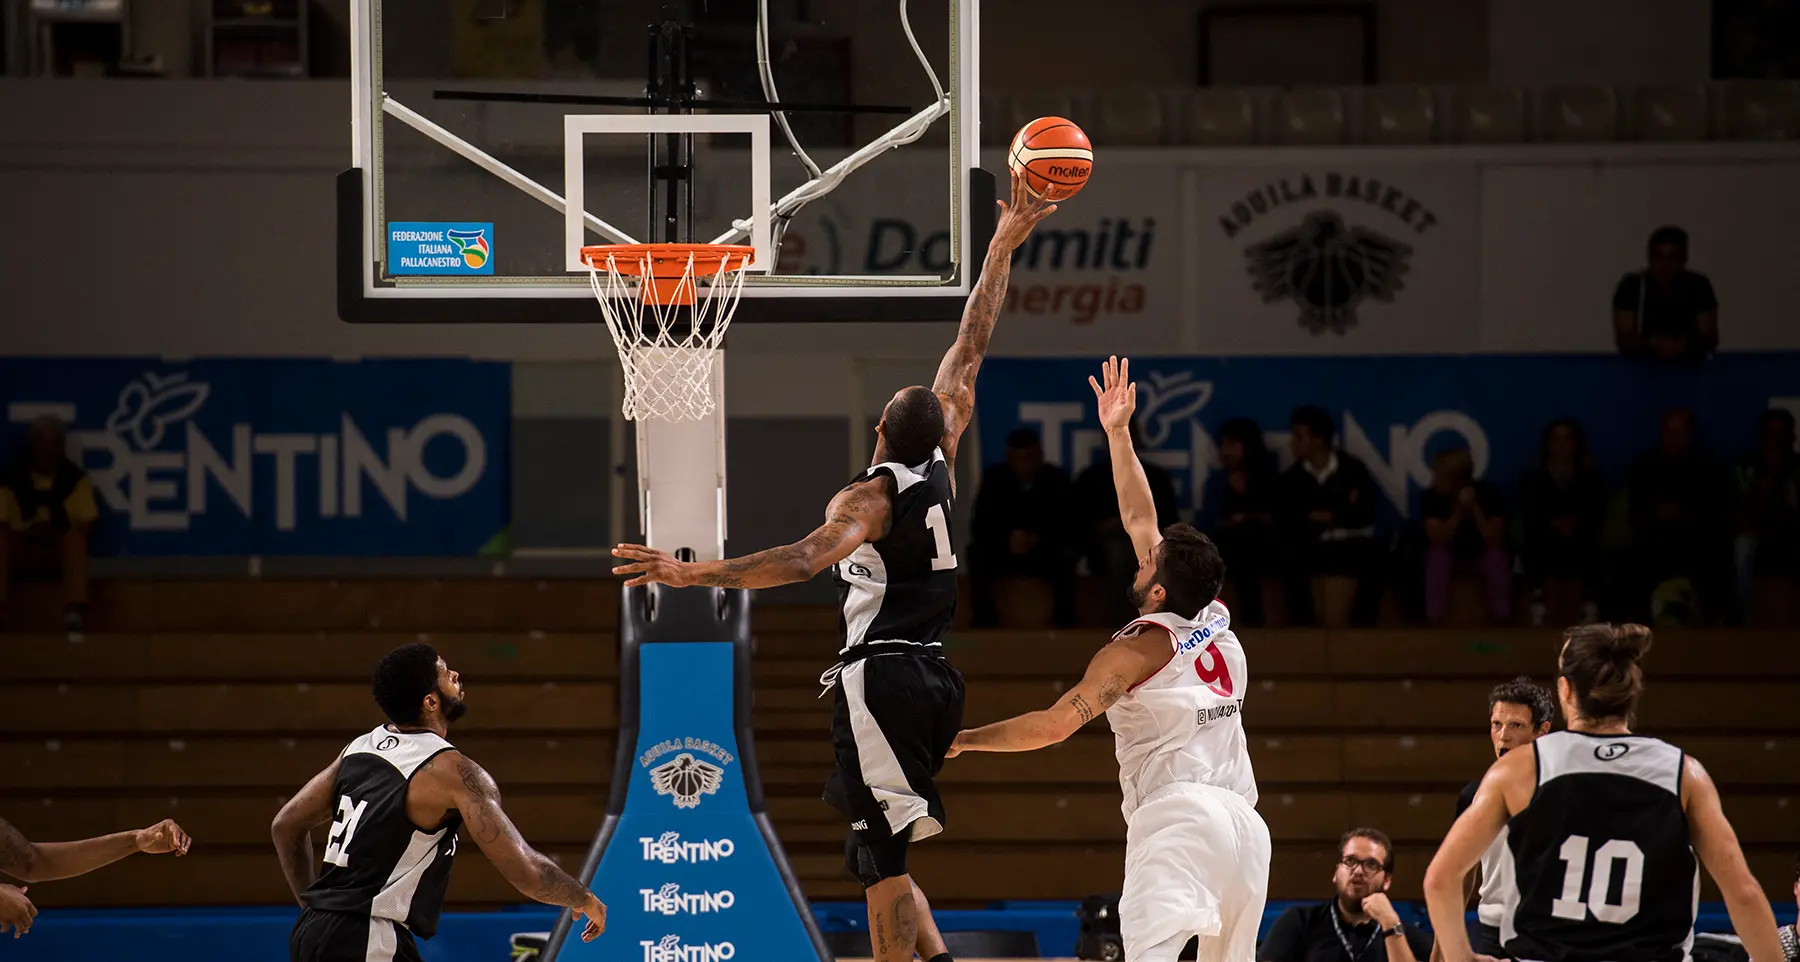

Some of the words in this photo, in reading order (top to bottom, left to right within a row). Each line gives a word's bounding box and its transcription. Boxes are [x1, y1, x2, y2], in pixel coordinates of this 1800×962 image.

[1048, 165, 1090, 178] molten
[1218, 172, 1318, 239] AQUILA
[1324, 171, 1438, 234] BASKET
[391, 230, 444, 242] FEDERAZIONE
[418, 243, 453, 255] ITALIANA
[867, 217, 1157, 271] Domiti
[400, 256, 462, 268] PALLACANESTRO
[1194, 641, 1233, 698] 9
[639, 737, 684, 769] AQUILA
[684, 736, 735, 766] BASKET
[322, 794, 369, 868] 21
[638, 836, 735, 864] TRENTINO
[1550, 833, 1646, 925] 10
[638, 888, 736, 916] TRENTINO
[638, 939, 736, 962] TRENTINO
